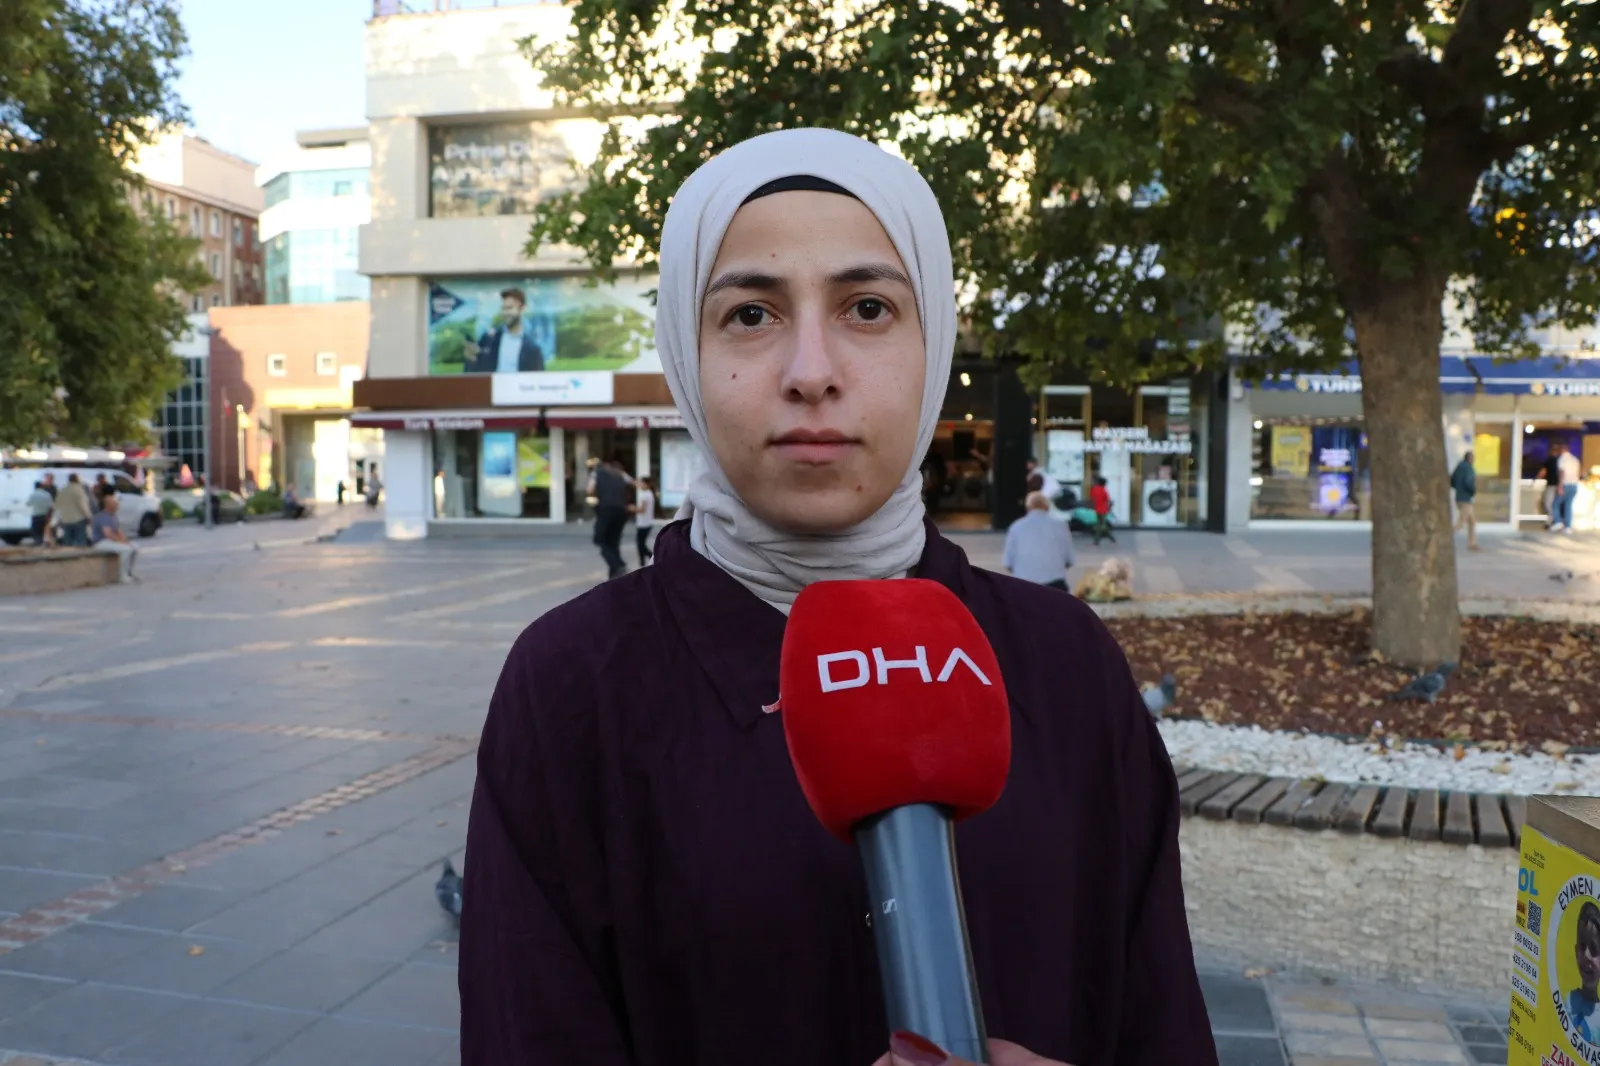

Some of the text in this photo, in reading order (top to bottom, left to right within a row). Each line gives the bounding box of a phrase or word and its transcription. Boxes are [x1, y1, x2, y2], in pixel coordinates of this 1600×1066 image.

[816, 645, 992, 693] DHA
[1558, 876, 1593, 910] EYMEN
[1552, 990, 1569, 1031] DMD
